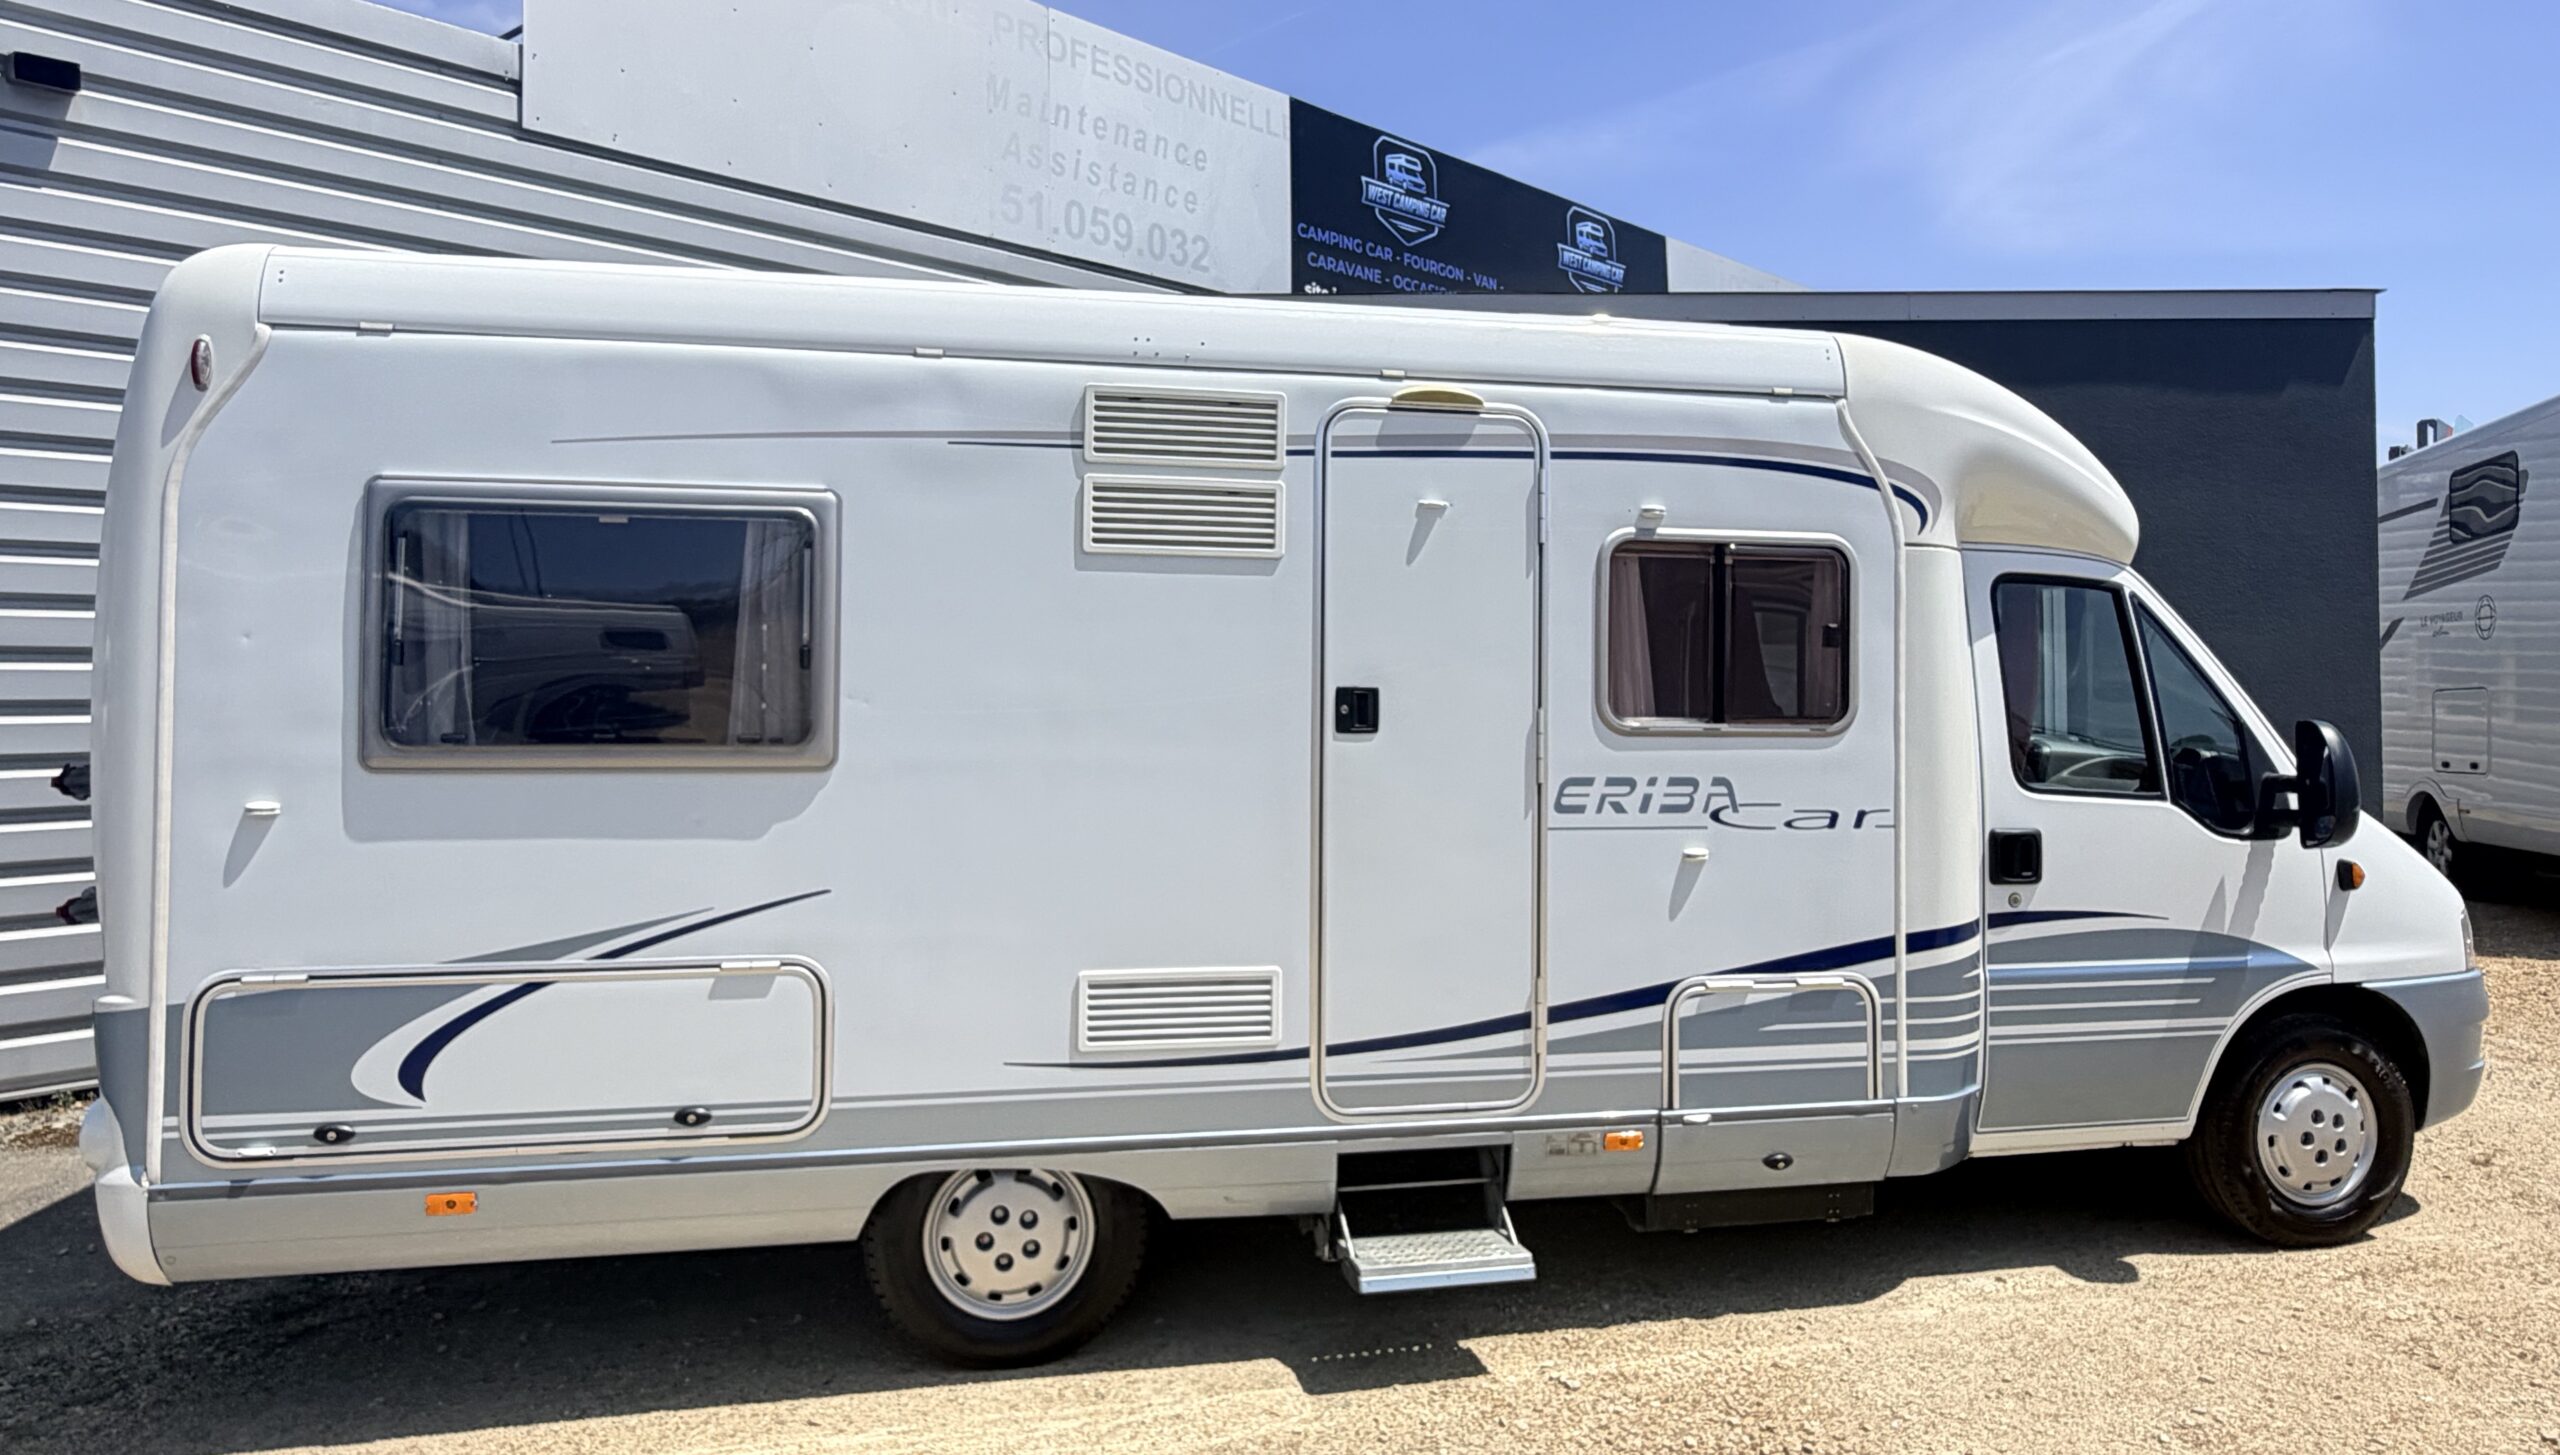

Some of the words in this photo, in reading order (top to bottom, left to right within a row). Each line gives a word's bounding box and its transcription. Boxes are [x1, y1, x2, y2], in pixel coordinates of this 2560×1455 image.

[986, 72, 1209, 173] Maintenance
[1002, 131, 1199, 215] Assistance
[1367, 183, 1394, 207] WEST
[1393, 192, 1431, 219] CAMPING
[1430, 204, 1448, 223] CAR
[1001, 184, 1212, 274] 51.059.032
[1297, 222, 1363, 255] CAMPING
[1365, 242, 1393, 263] CAR
[1403, 252, 1464, 283] FOURGON
[1473, 271, 1498, 291] VAN
[1306, 251, 1383, 285] CARAVANE
[1709, 802, 1892, 831] Car
